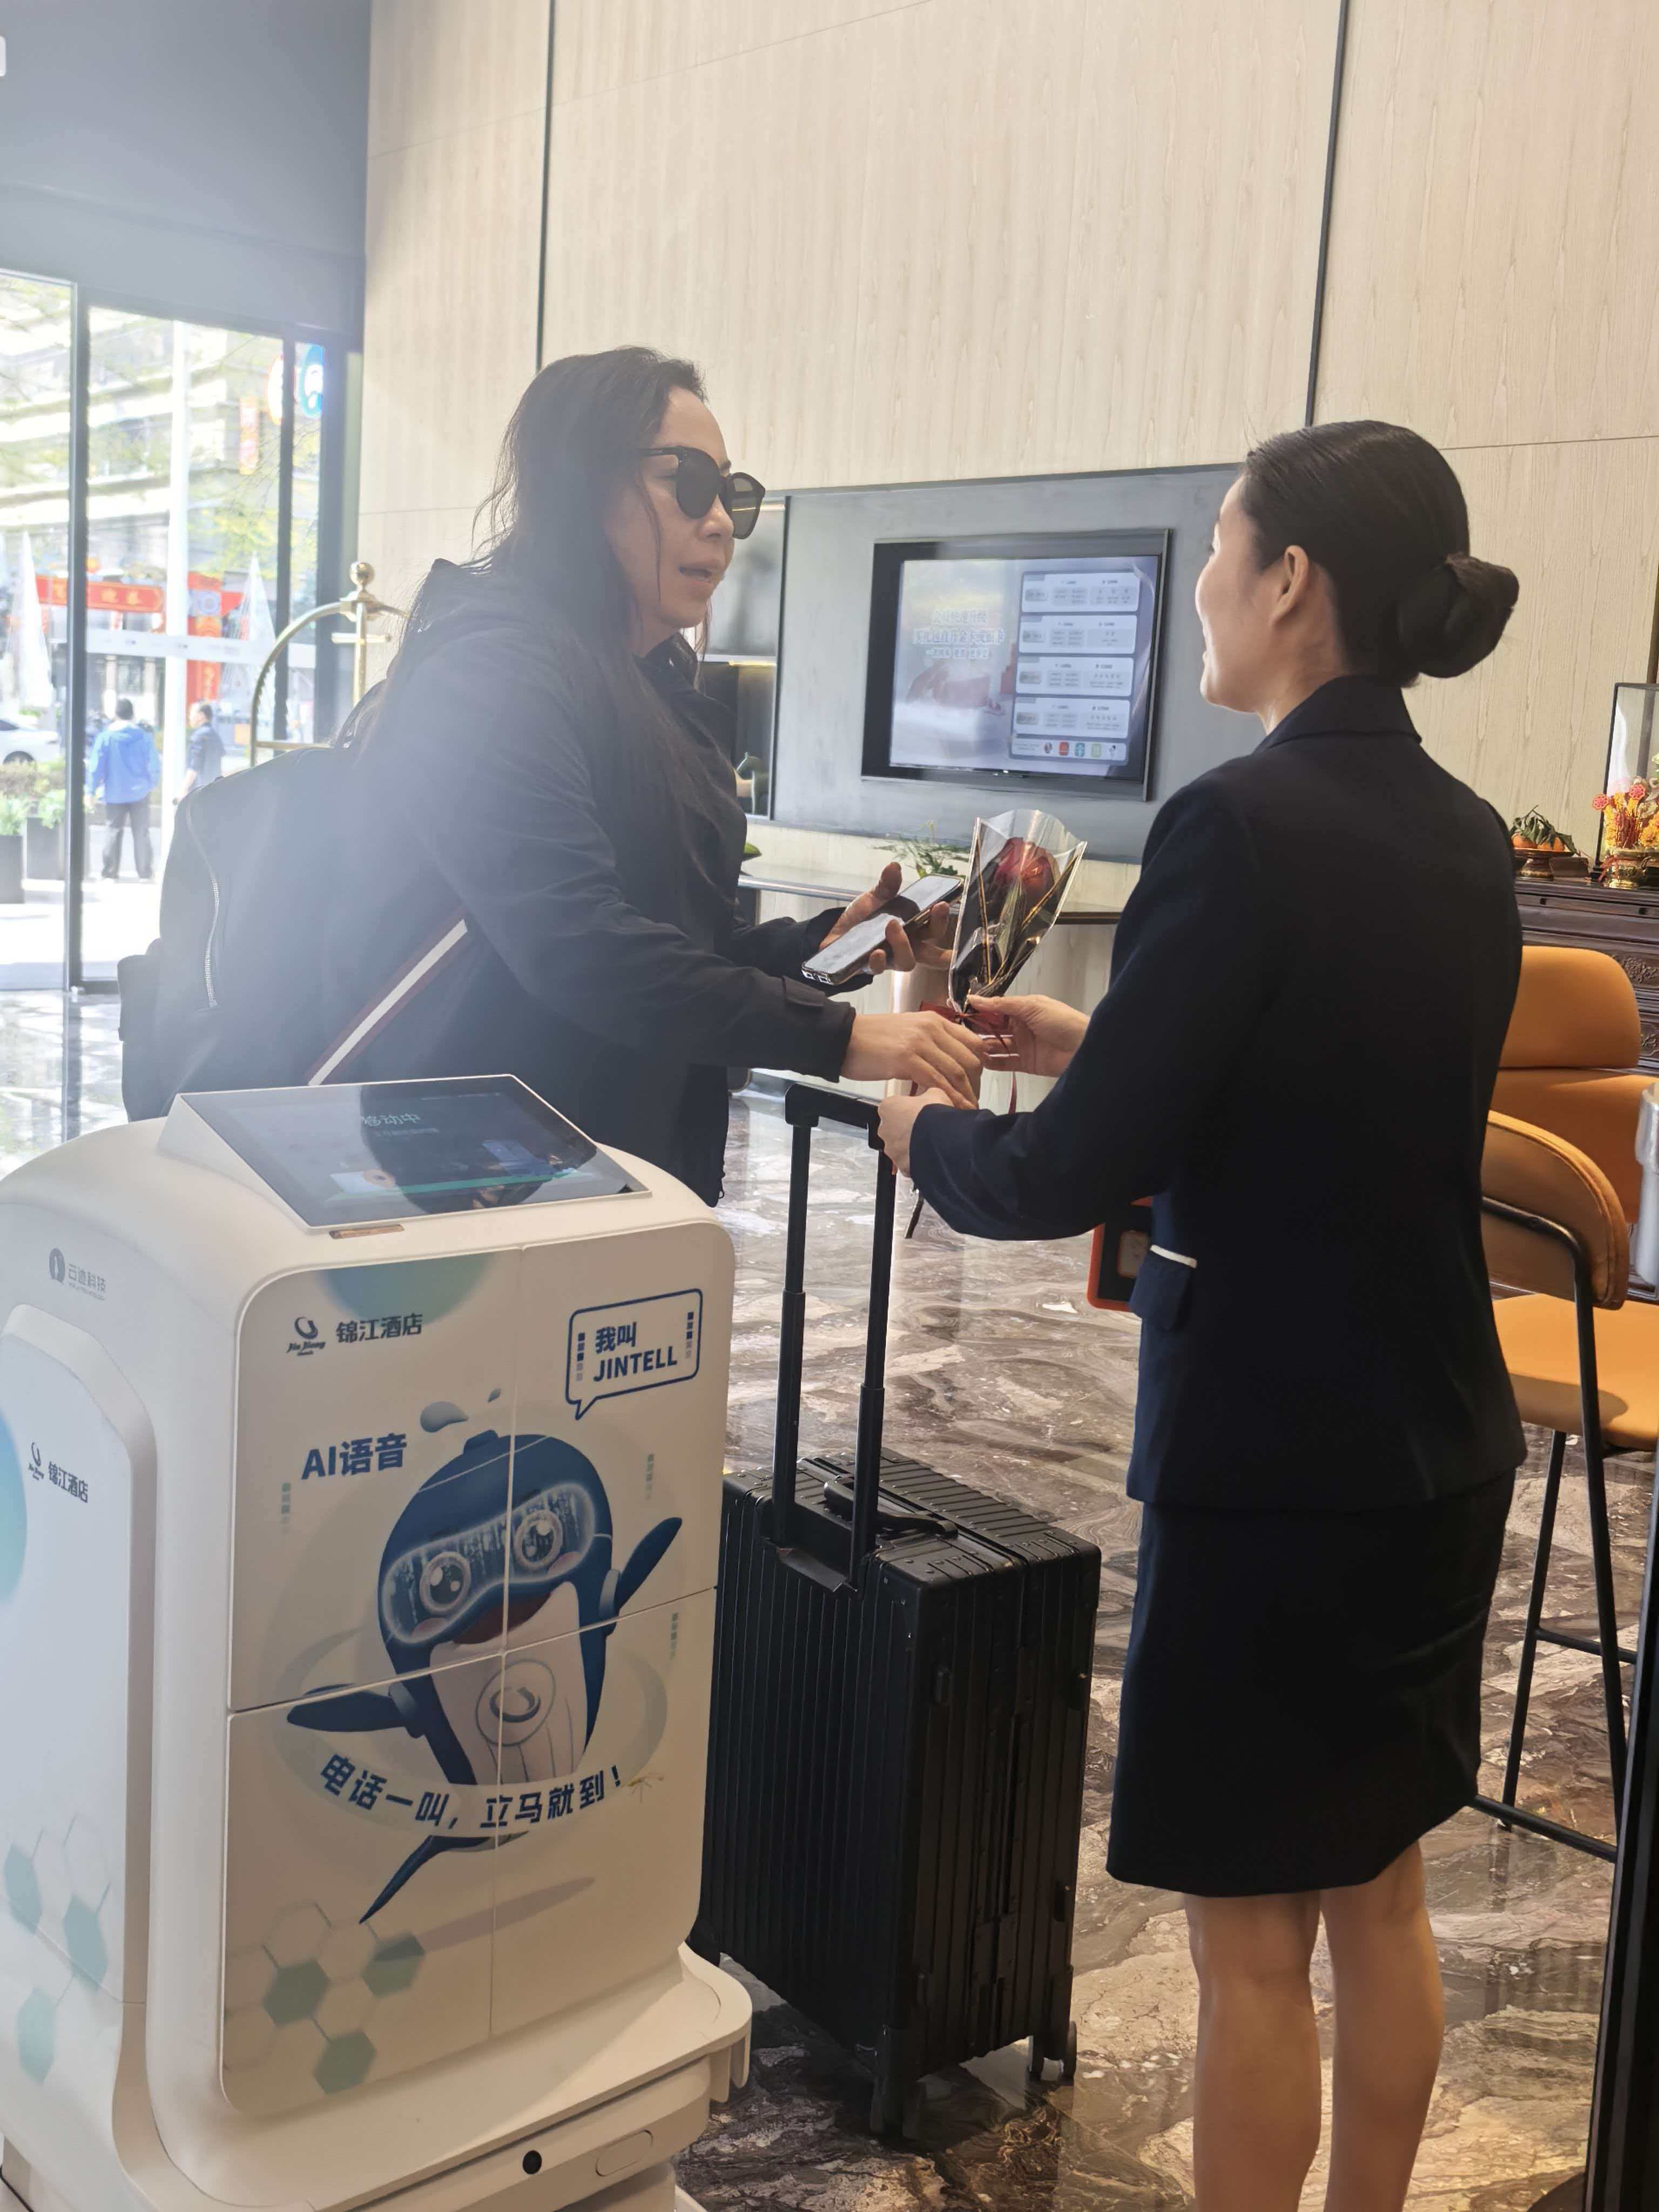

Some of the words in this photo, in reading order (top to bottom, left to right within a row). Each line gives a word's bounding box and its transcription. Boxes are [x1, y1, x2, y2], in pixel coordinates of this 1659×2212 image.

[335, 1313, 423, 1343] 锦江酒店
[595, 1321, 637, 1354] 我叫
[593, 1345, 678, 1381] JINTELL
[301, 1432, 407, 1480] AI语音
